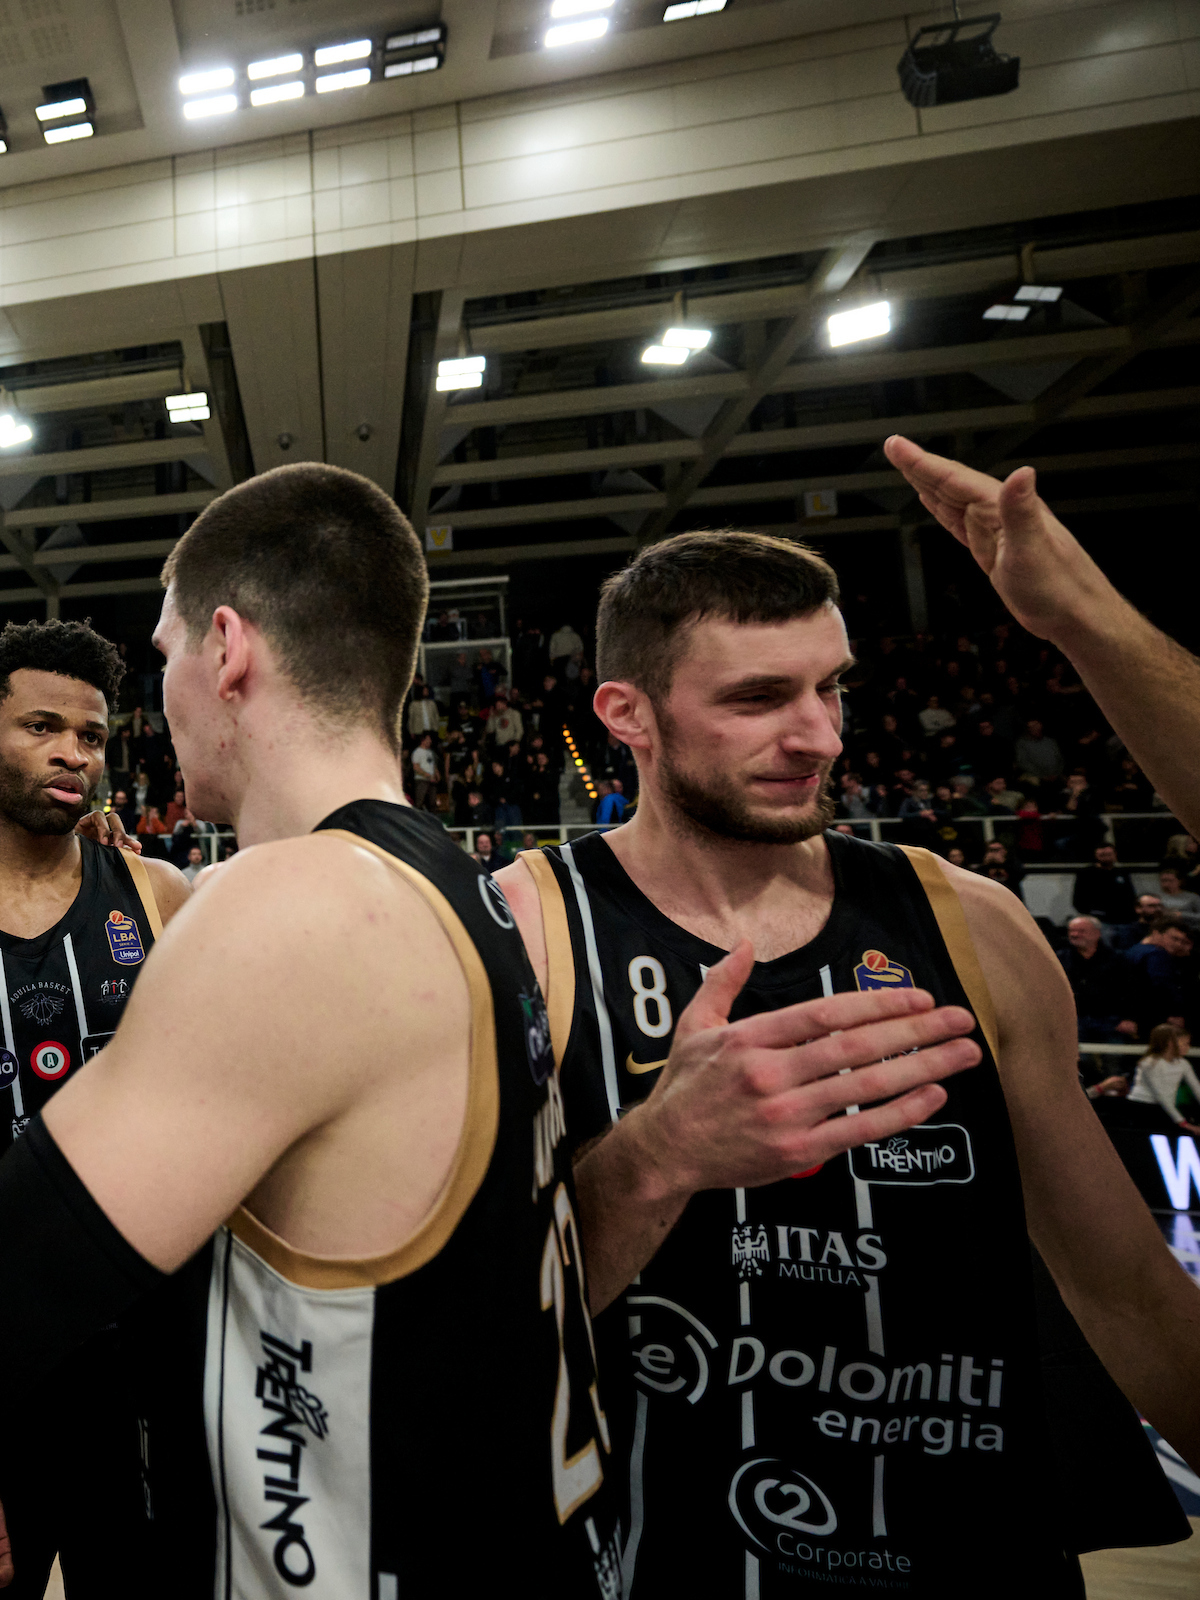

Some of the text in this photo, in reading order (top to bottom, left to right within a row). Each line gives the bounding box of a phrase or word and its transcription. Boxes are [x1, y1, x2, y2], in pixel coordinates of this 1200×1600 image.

[430, 528, 448, 546] V
[112, 932, 137, 943] LBA
[119, 949, 140, 960] Unipol
[10, 981, 72, 1003] AQUILA BASKET
[628, 955, 673, 1038] 8
[47, 1054, 55, 1067] A
[864, 1142, 956, 1174] TRENTINO
[776, 1225, 888, 1271] ITAS
[779, 1262, 862, 1287] MUTUA
[727, 1336, 1004, 1408] Dolomiti
[812, 1409, 1004, 1456] energia
[255, 1330, 316, 1588] TRENTINO
[776, 1532, 912, 1573] Corporate
